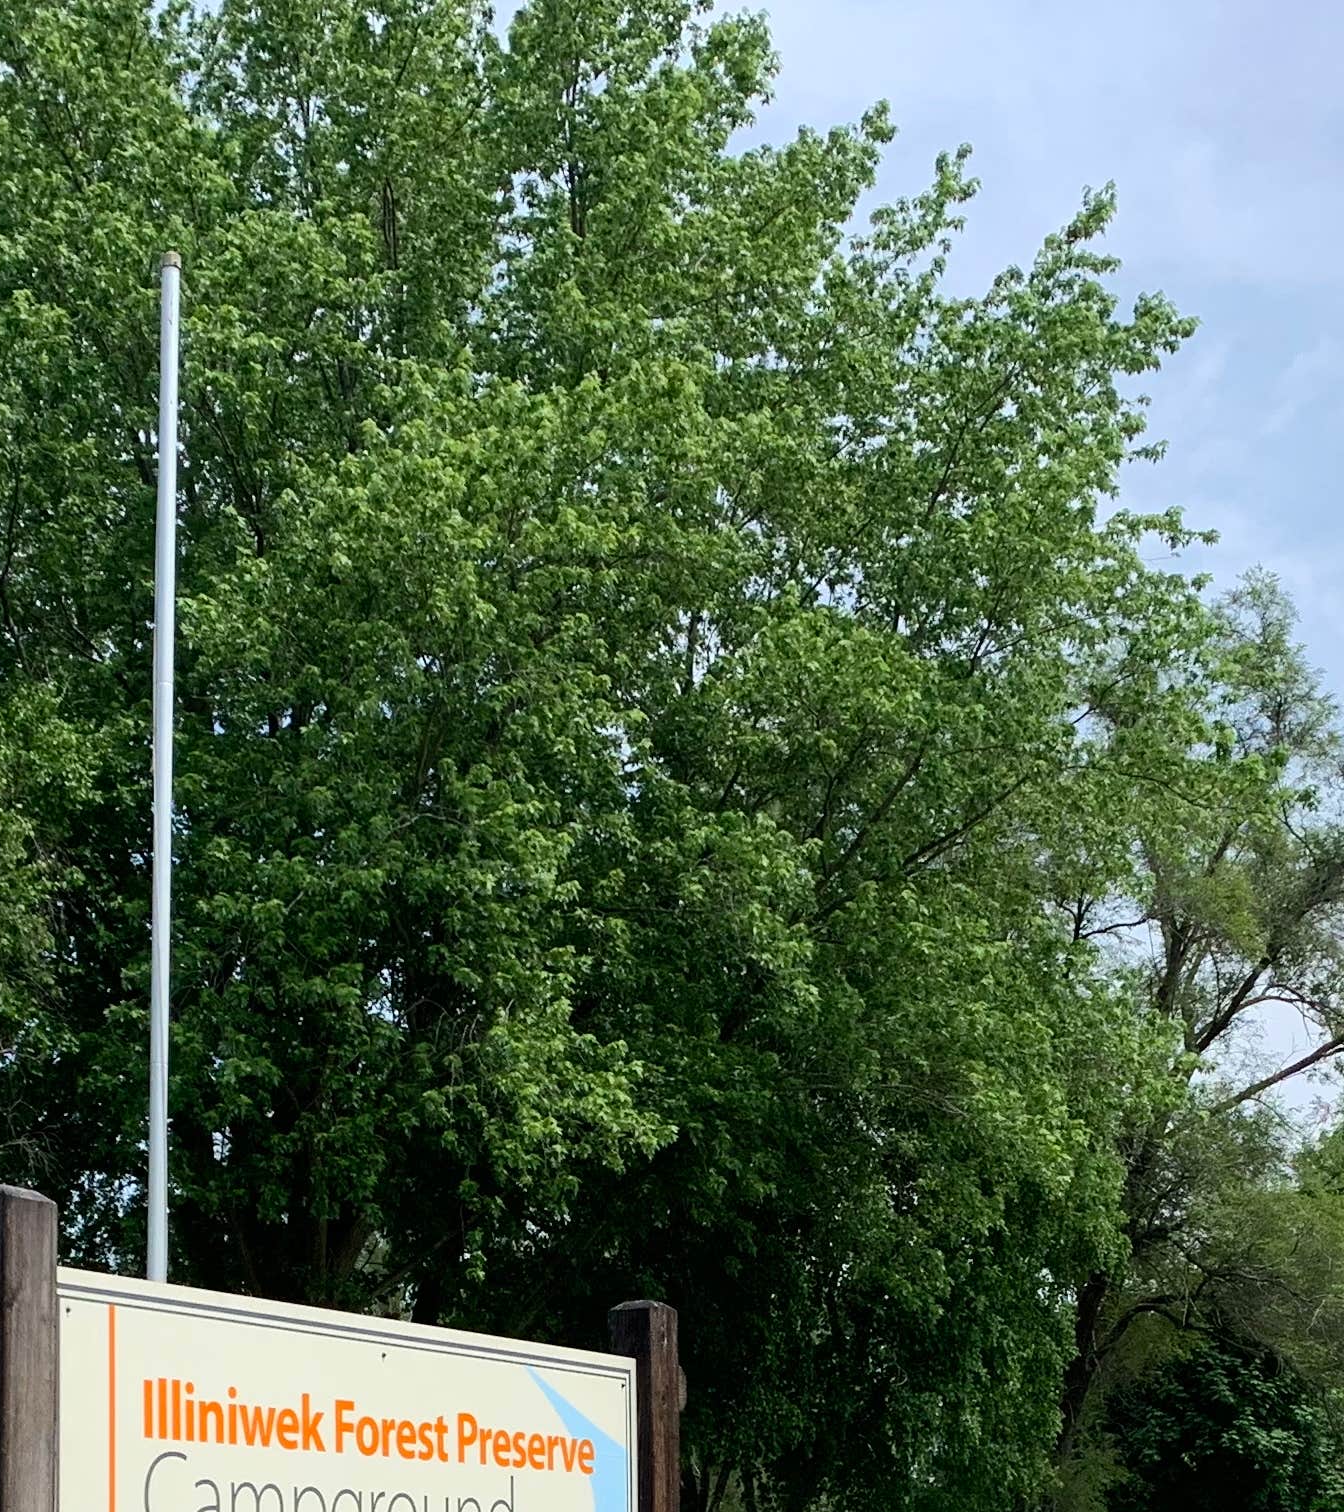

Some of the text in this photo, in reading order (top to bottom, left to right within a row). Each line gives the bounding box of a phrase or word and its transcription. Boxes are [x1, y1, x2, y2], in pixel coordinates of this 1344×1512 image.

[143, 1378, 595, 1475] Illiniwek Forest Preserve
